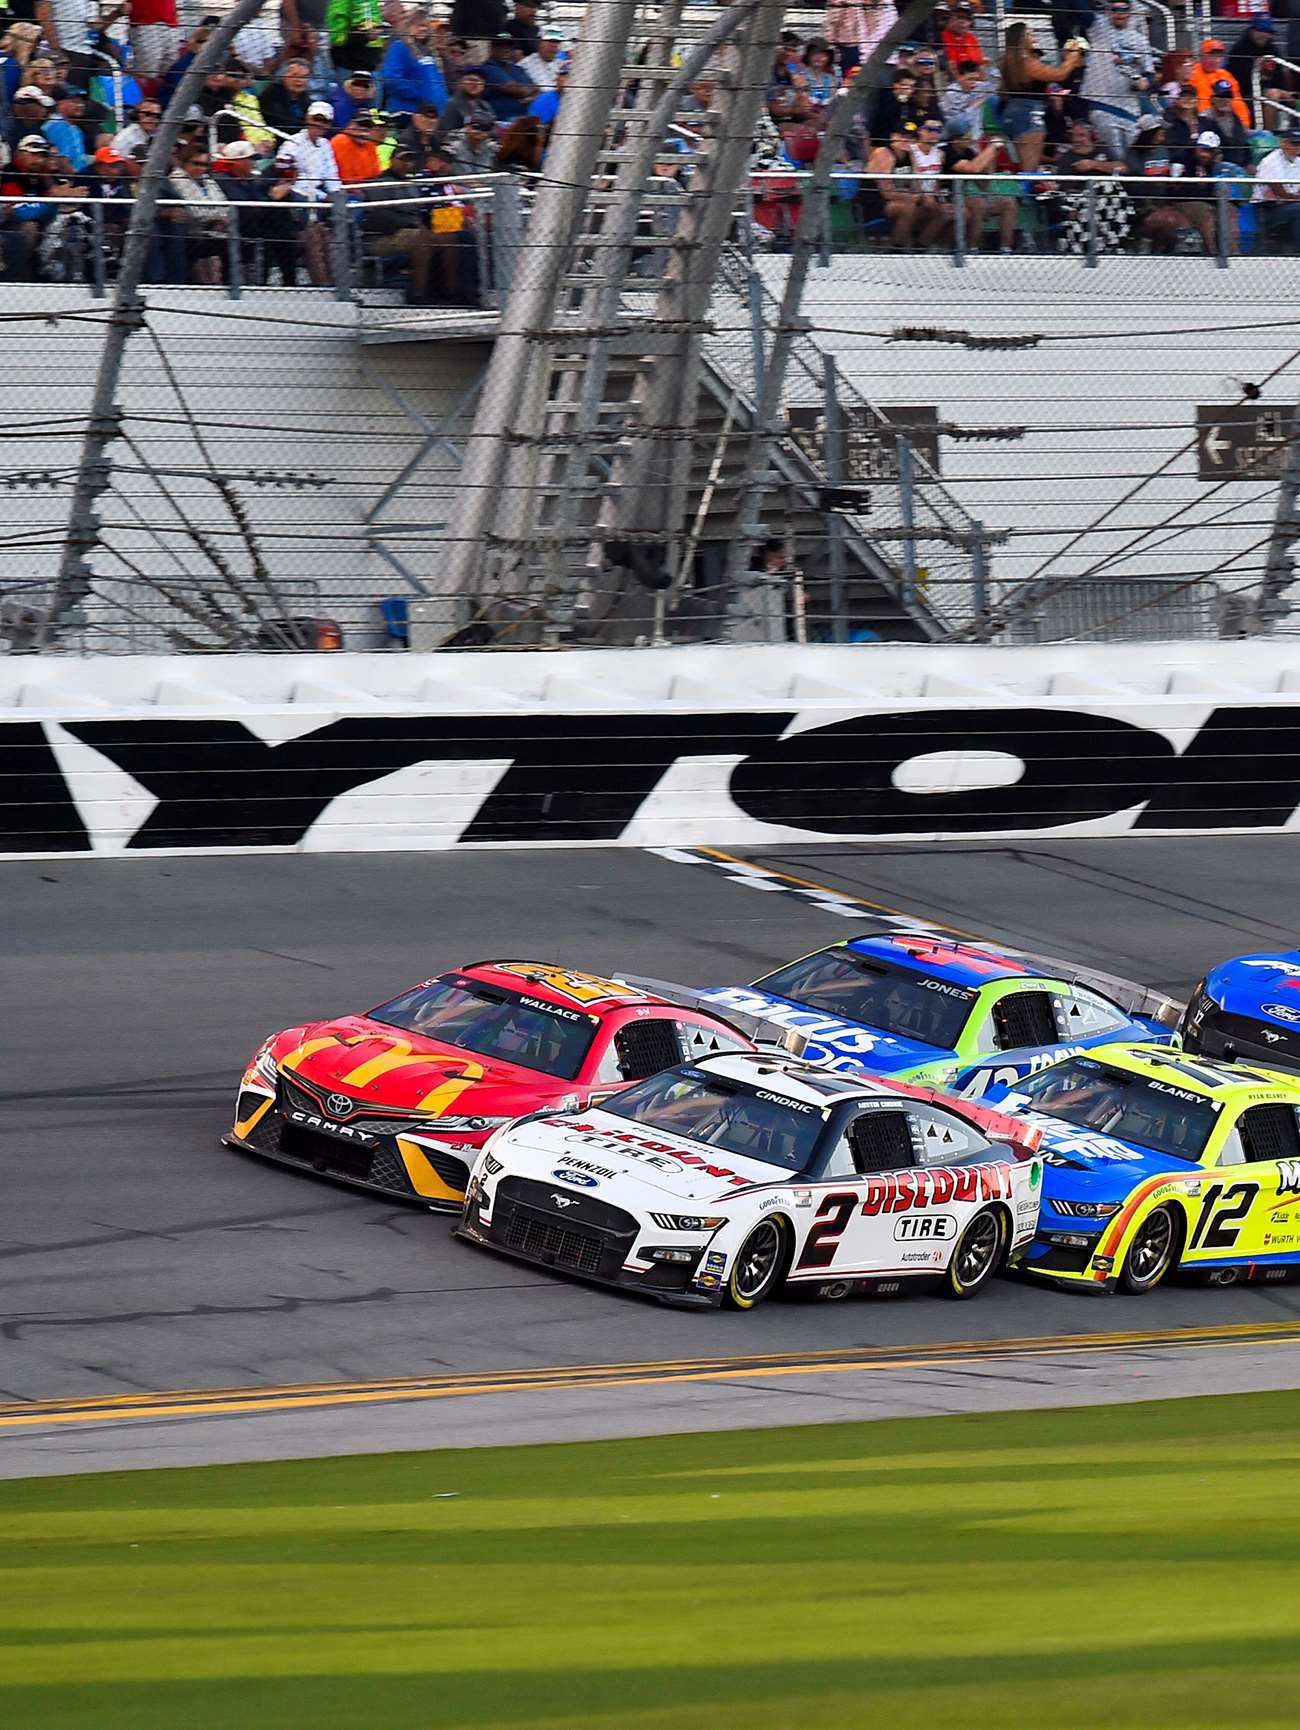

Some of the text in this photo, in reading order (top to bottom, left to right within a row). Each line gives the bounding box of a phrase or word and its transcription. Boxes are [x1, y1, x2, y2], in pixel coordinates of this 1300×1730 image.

[917, 979, 974, 1000] JONES
[519, 996, 582, 1021] WALLACE
[1267, 1006, 1300, 1022] Ford
[755, 1090, 814, 1114] CINDRIC
[1148, 1081, 1208, 1105] BLANEY
[291, 1112, 374, 1141] CAMRY
[540, 1119, 757, 1187] DISCOUNT
[582, 1134, 673, 1168] TIRE
[557, 1154, 619, 1181] PENNZOIL
[558, 1170, 596, 1187] Ford
[480, 1173, 488, 1188] 2
[861, 1160, 1013, 1217] DISCOUNT
[900, 1216, 947, 1239] TIRE
[1189, 1184, 1260, 1250] 12
[796, 1192, 859, 1271] 2
